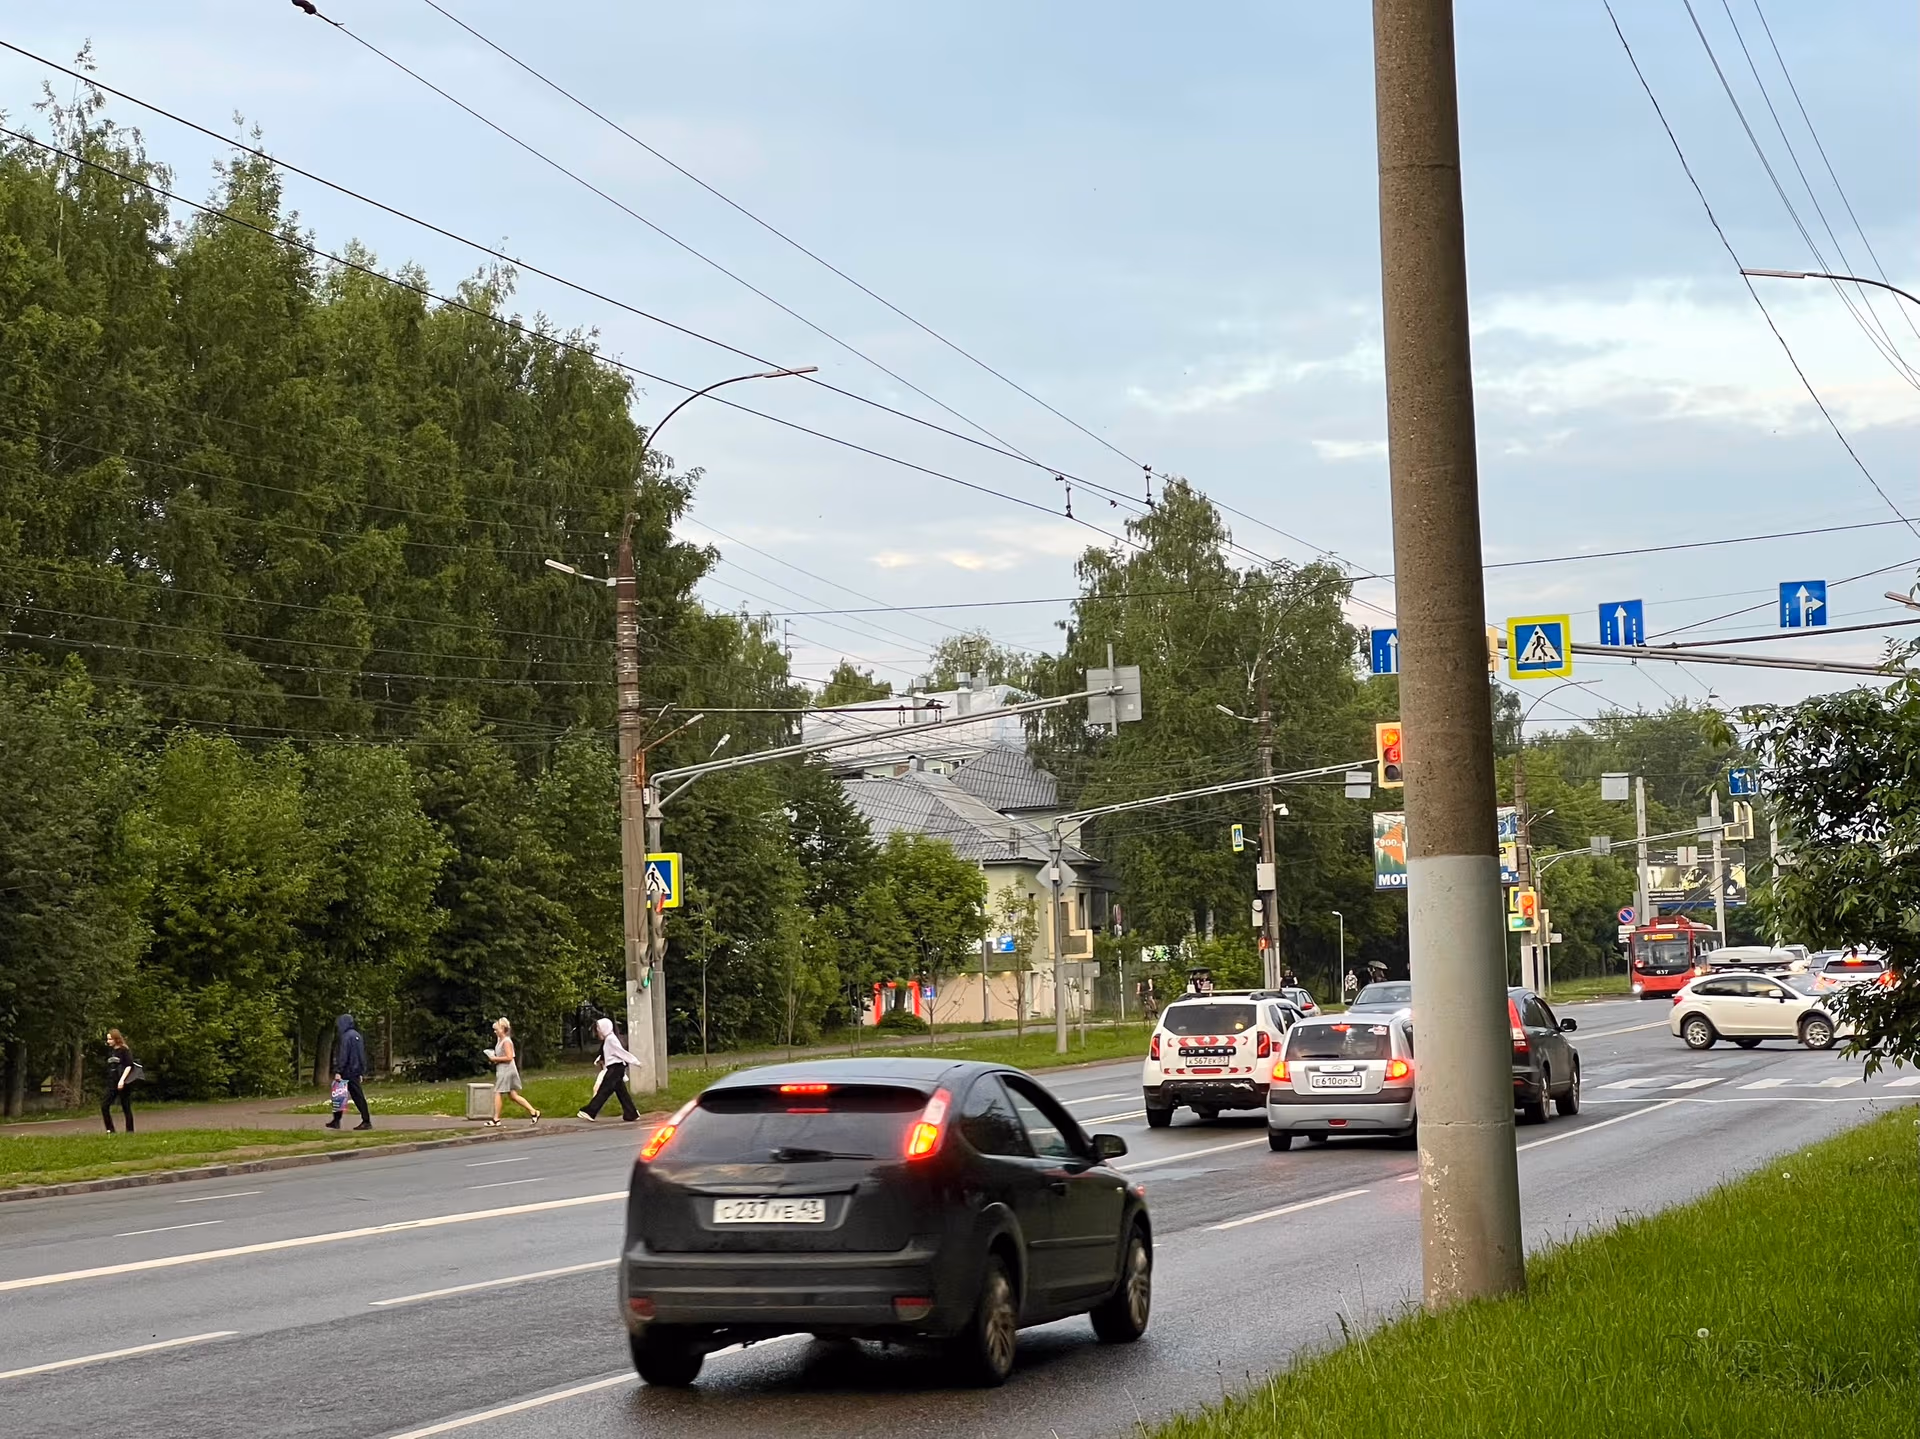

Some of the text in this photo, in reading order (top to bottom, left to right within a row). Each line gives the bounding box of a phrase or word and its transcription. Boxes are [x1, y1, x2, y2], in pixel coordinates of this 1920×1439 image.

[1379, 838, 1397, 847] 900
[1315, 1077, 1348, 1085] Е610ОР
[723, 1202, 794, 1219] С237УЕ
